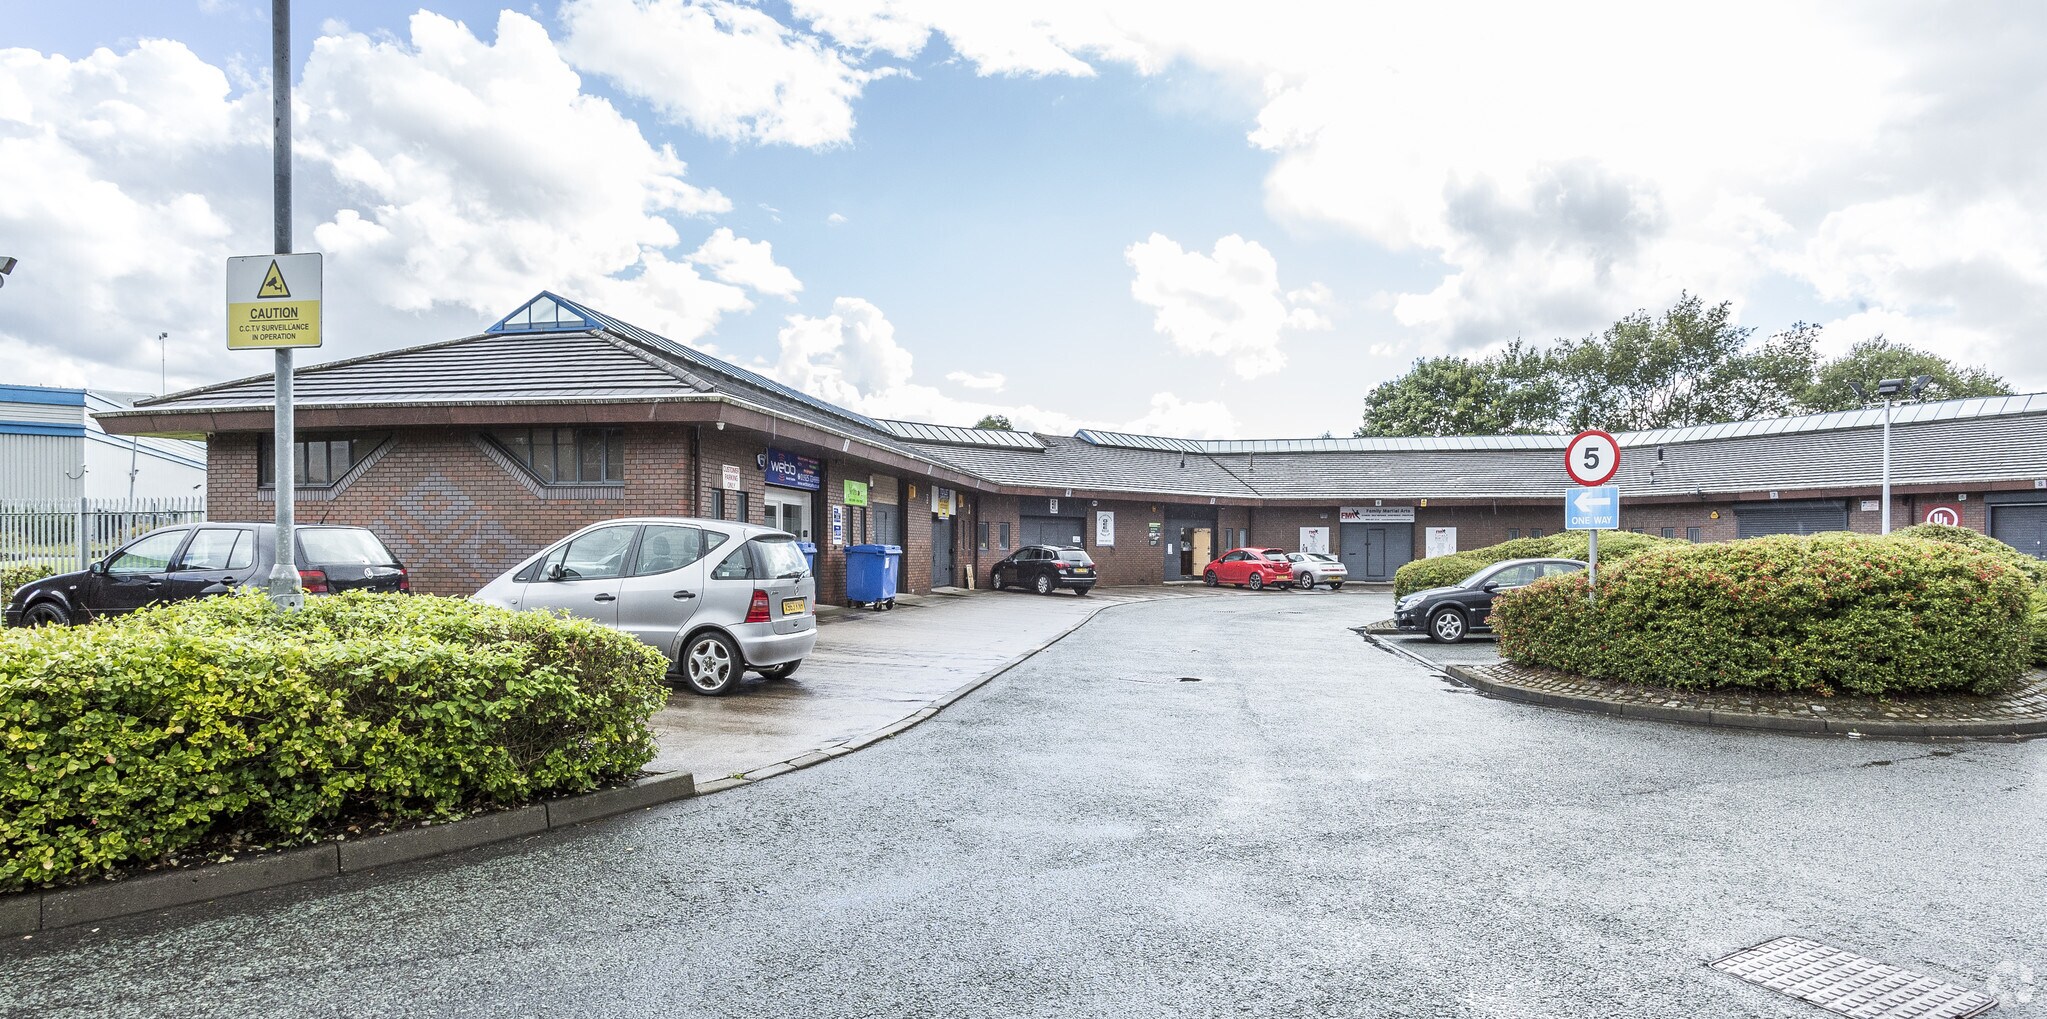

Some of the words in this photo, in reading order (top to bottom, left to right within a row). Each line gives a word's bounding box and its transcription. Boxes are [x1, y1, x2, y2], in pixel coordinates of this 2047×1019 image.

[250, 307, 298, 319] CAUTION
[261, 323, 309, 331] SURVEILLANCE
[1583, 447, 1599, 469] 5
[723, 465, 739, 473] CUSTOMER
[770, 460, 796, 475] webb
[724, 473, 739, 481] PARKING
[1571, 517, 1590, 525] ONE
[1593, 516, 1612, 524] WAY
